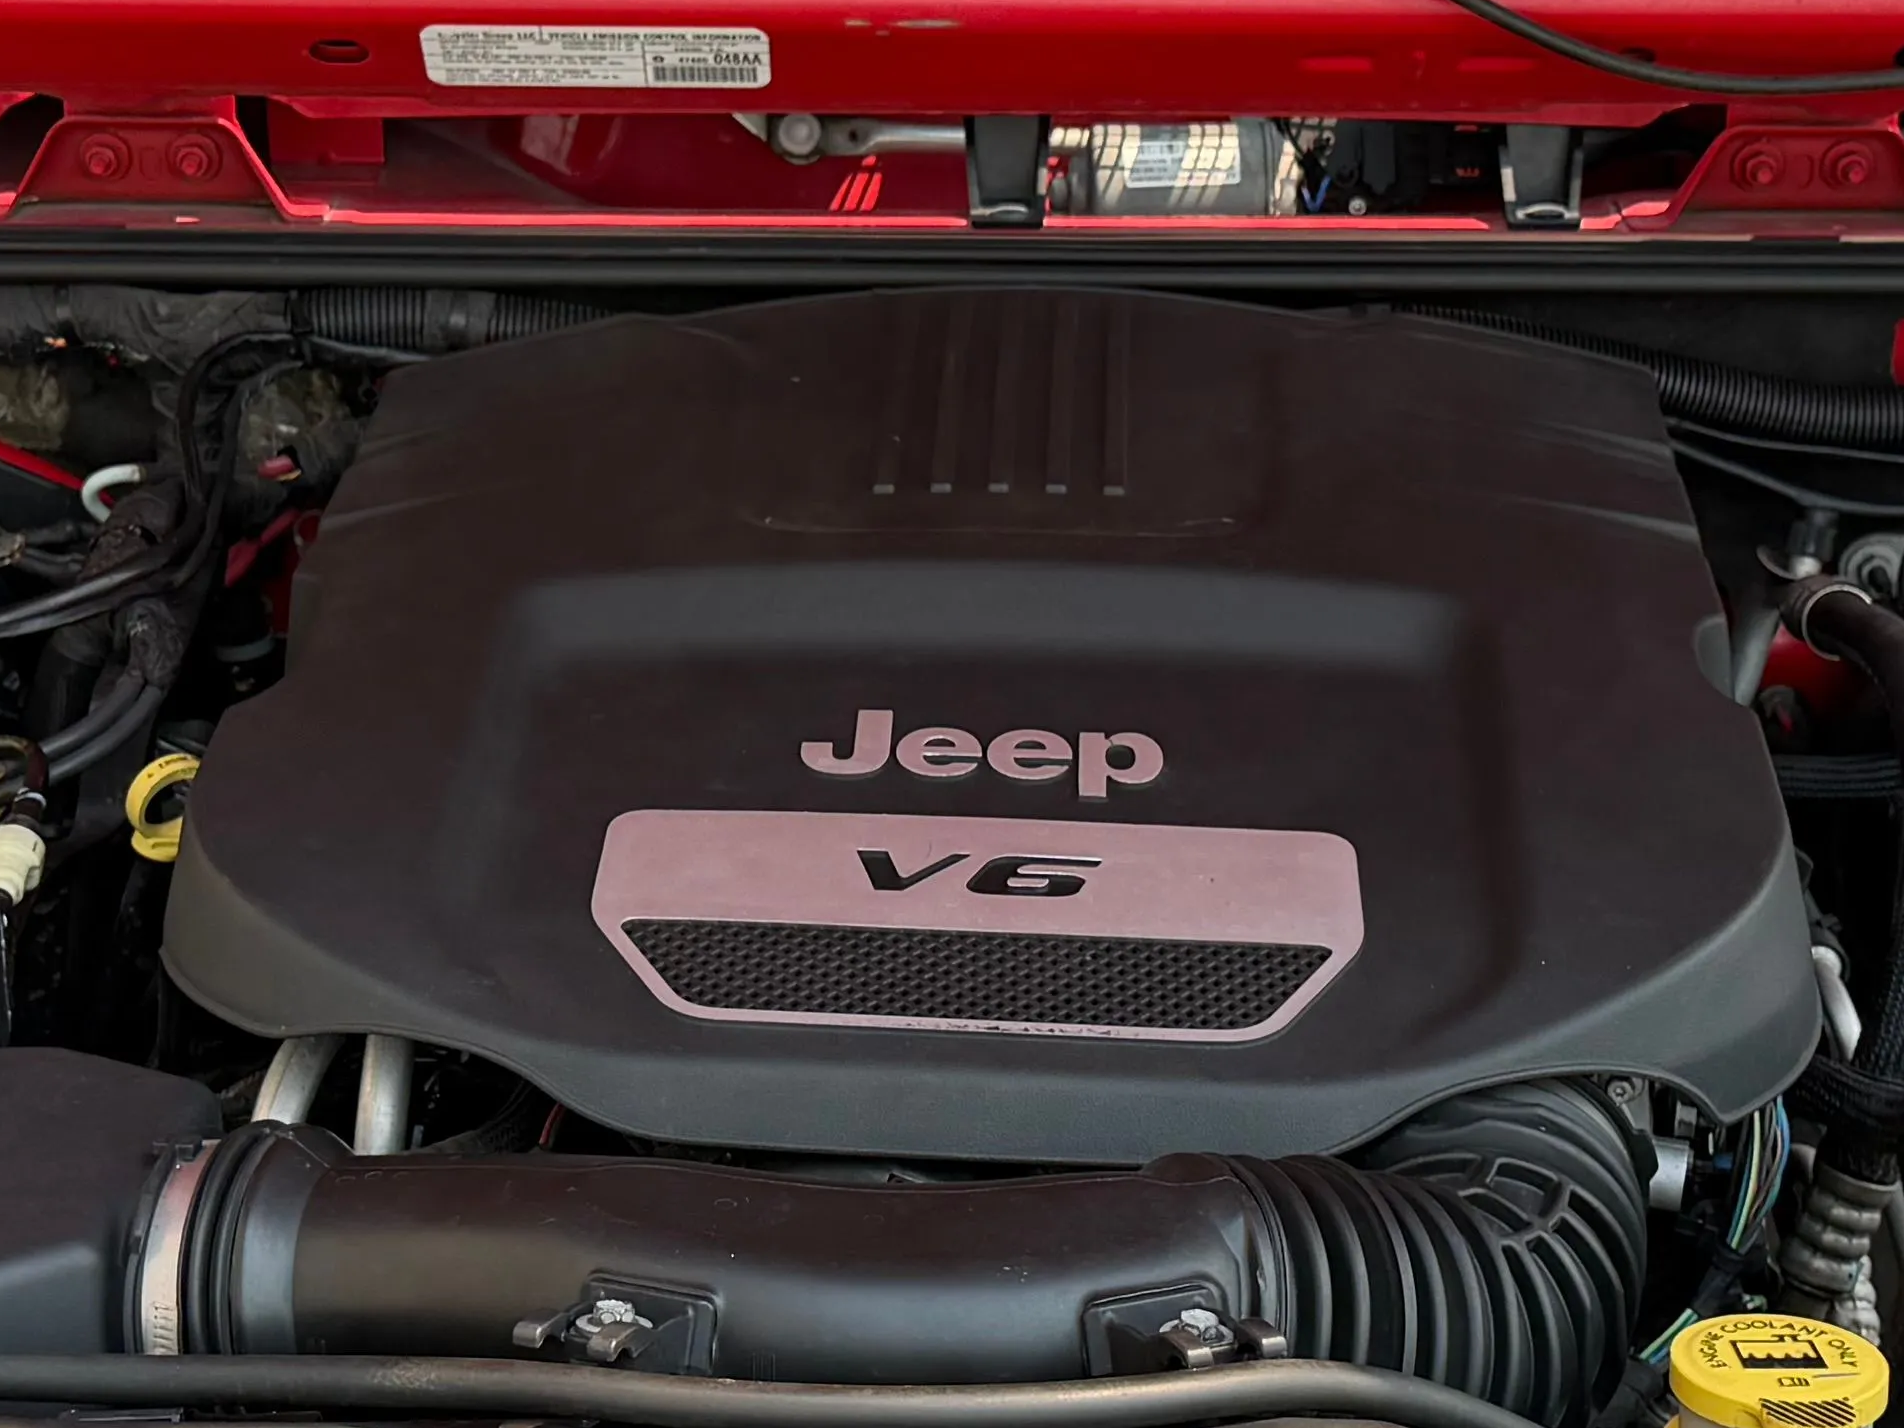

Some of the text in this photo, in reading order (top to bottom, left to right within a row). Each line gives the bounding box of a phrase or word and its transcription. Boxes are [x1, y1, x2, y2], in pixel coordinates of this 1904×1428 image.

[592, 32, 641, 40] EMISSION
[643, 32, 687, 41] CONTROL
[692, 33, 761, 41] INFORMATION
[800, 708, 1166, 799] Jeep
[856, 848, 1103, 897] V6
[1720, 1319, 1829, 1337] COOLANT
[1828, 1338, 1858, 1368] ONLY
